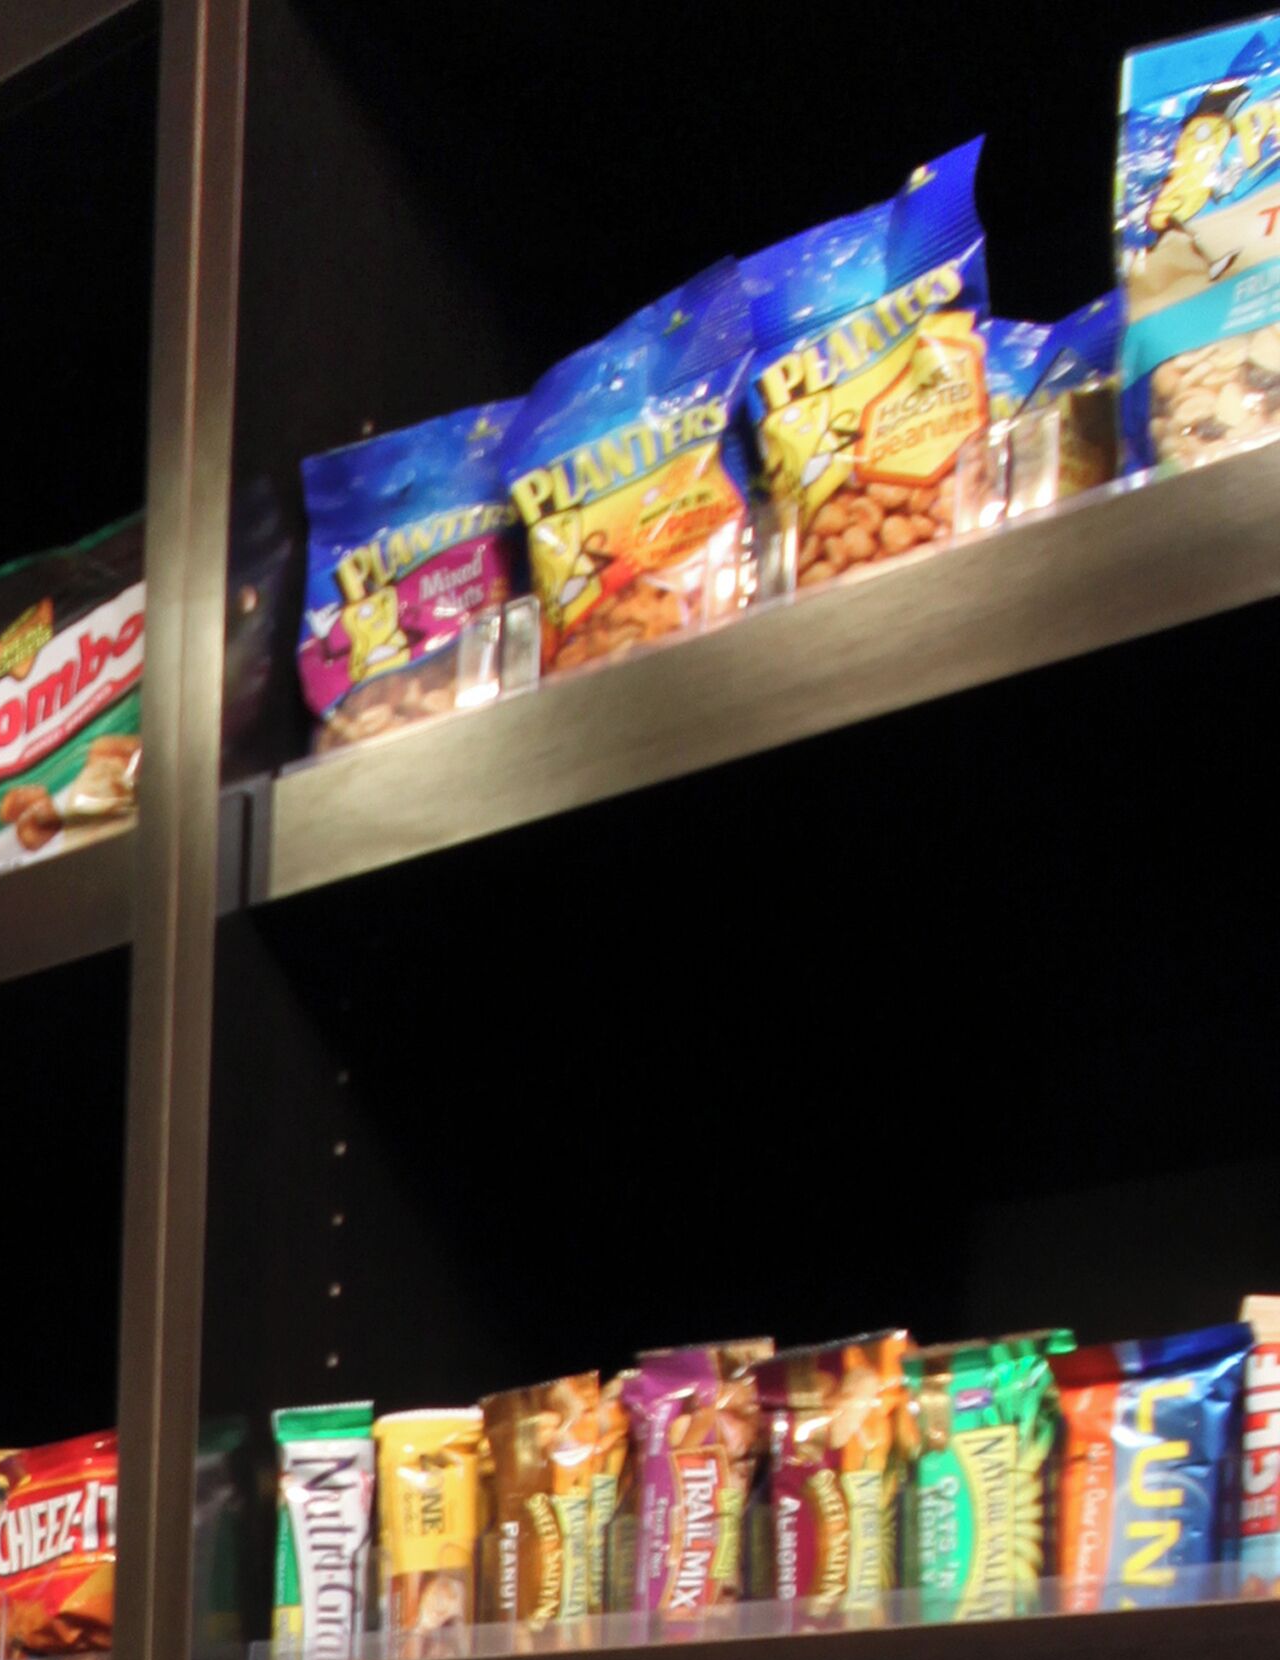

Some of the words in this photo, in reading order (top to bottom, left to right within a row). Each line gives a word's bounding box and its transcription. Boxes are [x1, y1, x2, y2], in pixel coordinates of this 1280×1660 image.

[758, 259, 964, 408] PLANTERS
[510, 399, 729, 527] PLANTERS
[336, 504, 521, 602] PLANTERS
[419, 552, 485, 601] Mixed
[680, 1458, 720, 1546] TRAIL
[934, 1477, 959, 1553] OATS
[964, 1435, 1006, 1526] NATURE
[1119, 1379, 1194, 1610] LUN
[500, 1521, 521, 1611] PEANUT
[669, 1550, 708, 1612] MIX
[776, 1496, 801, 1601] ALMOND
[968, 1535, 1007, 1620] VALLEY
